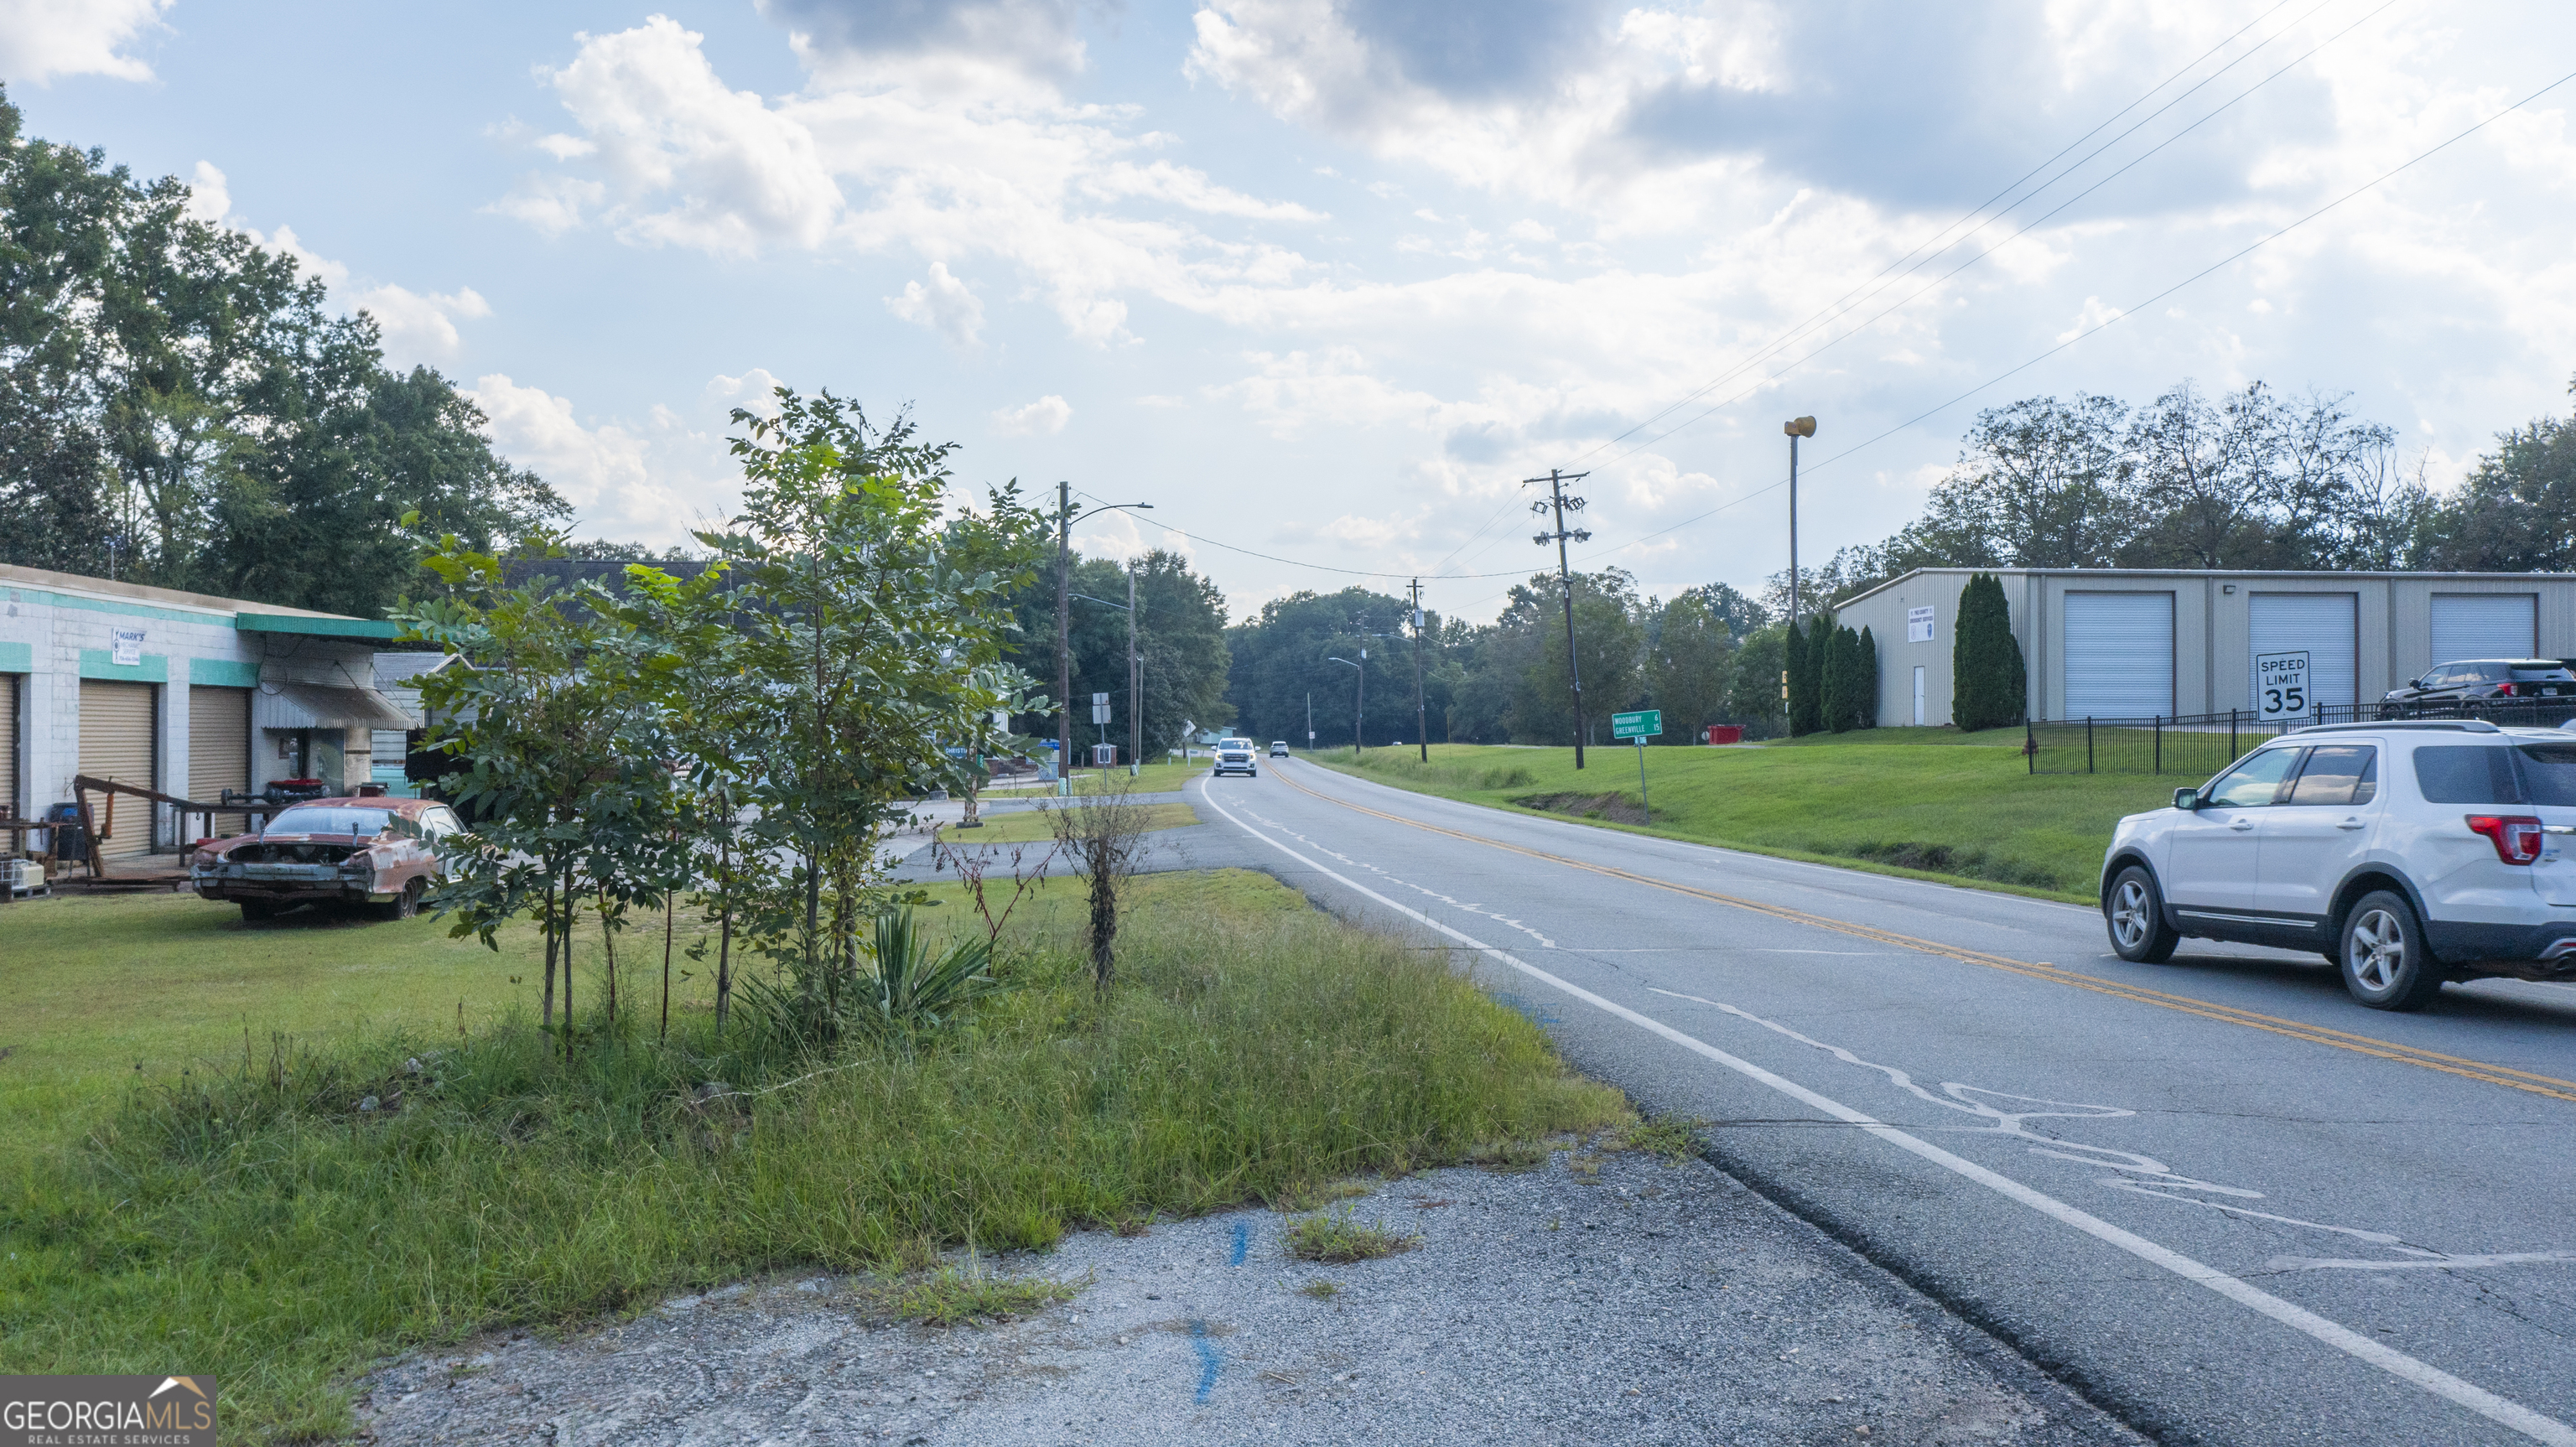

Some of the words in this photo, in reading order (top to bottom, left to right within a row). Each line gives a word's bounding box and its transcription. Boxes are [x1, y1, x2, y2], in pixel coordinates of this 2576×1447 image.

[119, 631, 145, 642] MARK'S
[2262, 659, 2305, 672] SPEED
[2266, 673, 2300, 686] LIMIT
[2264, 687, 2304, 713] 35
[1614, 715, 1642, 725] WOODBURY
[1654, 713, 1659, 722] 6
[1615, 724, 1646, 735] GREENVILLE
[1654, 723, 1660, 731] 15
